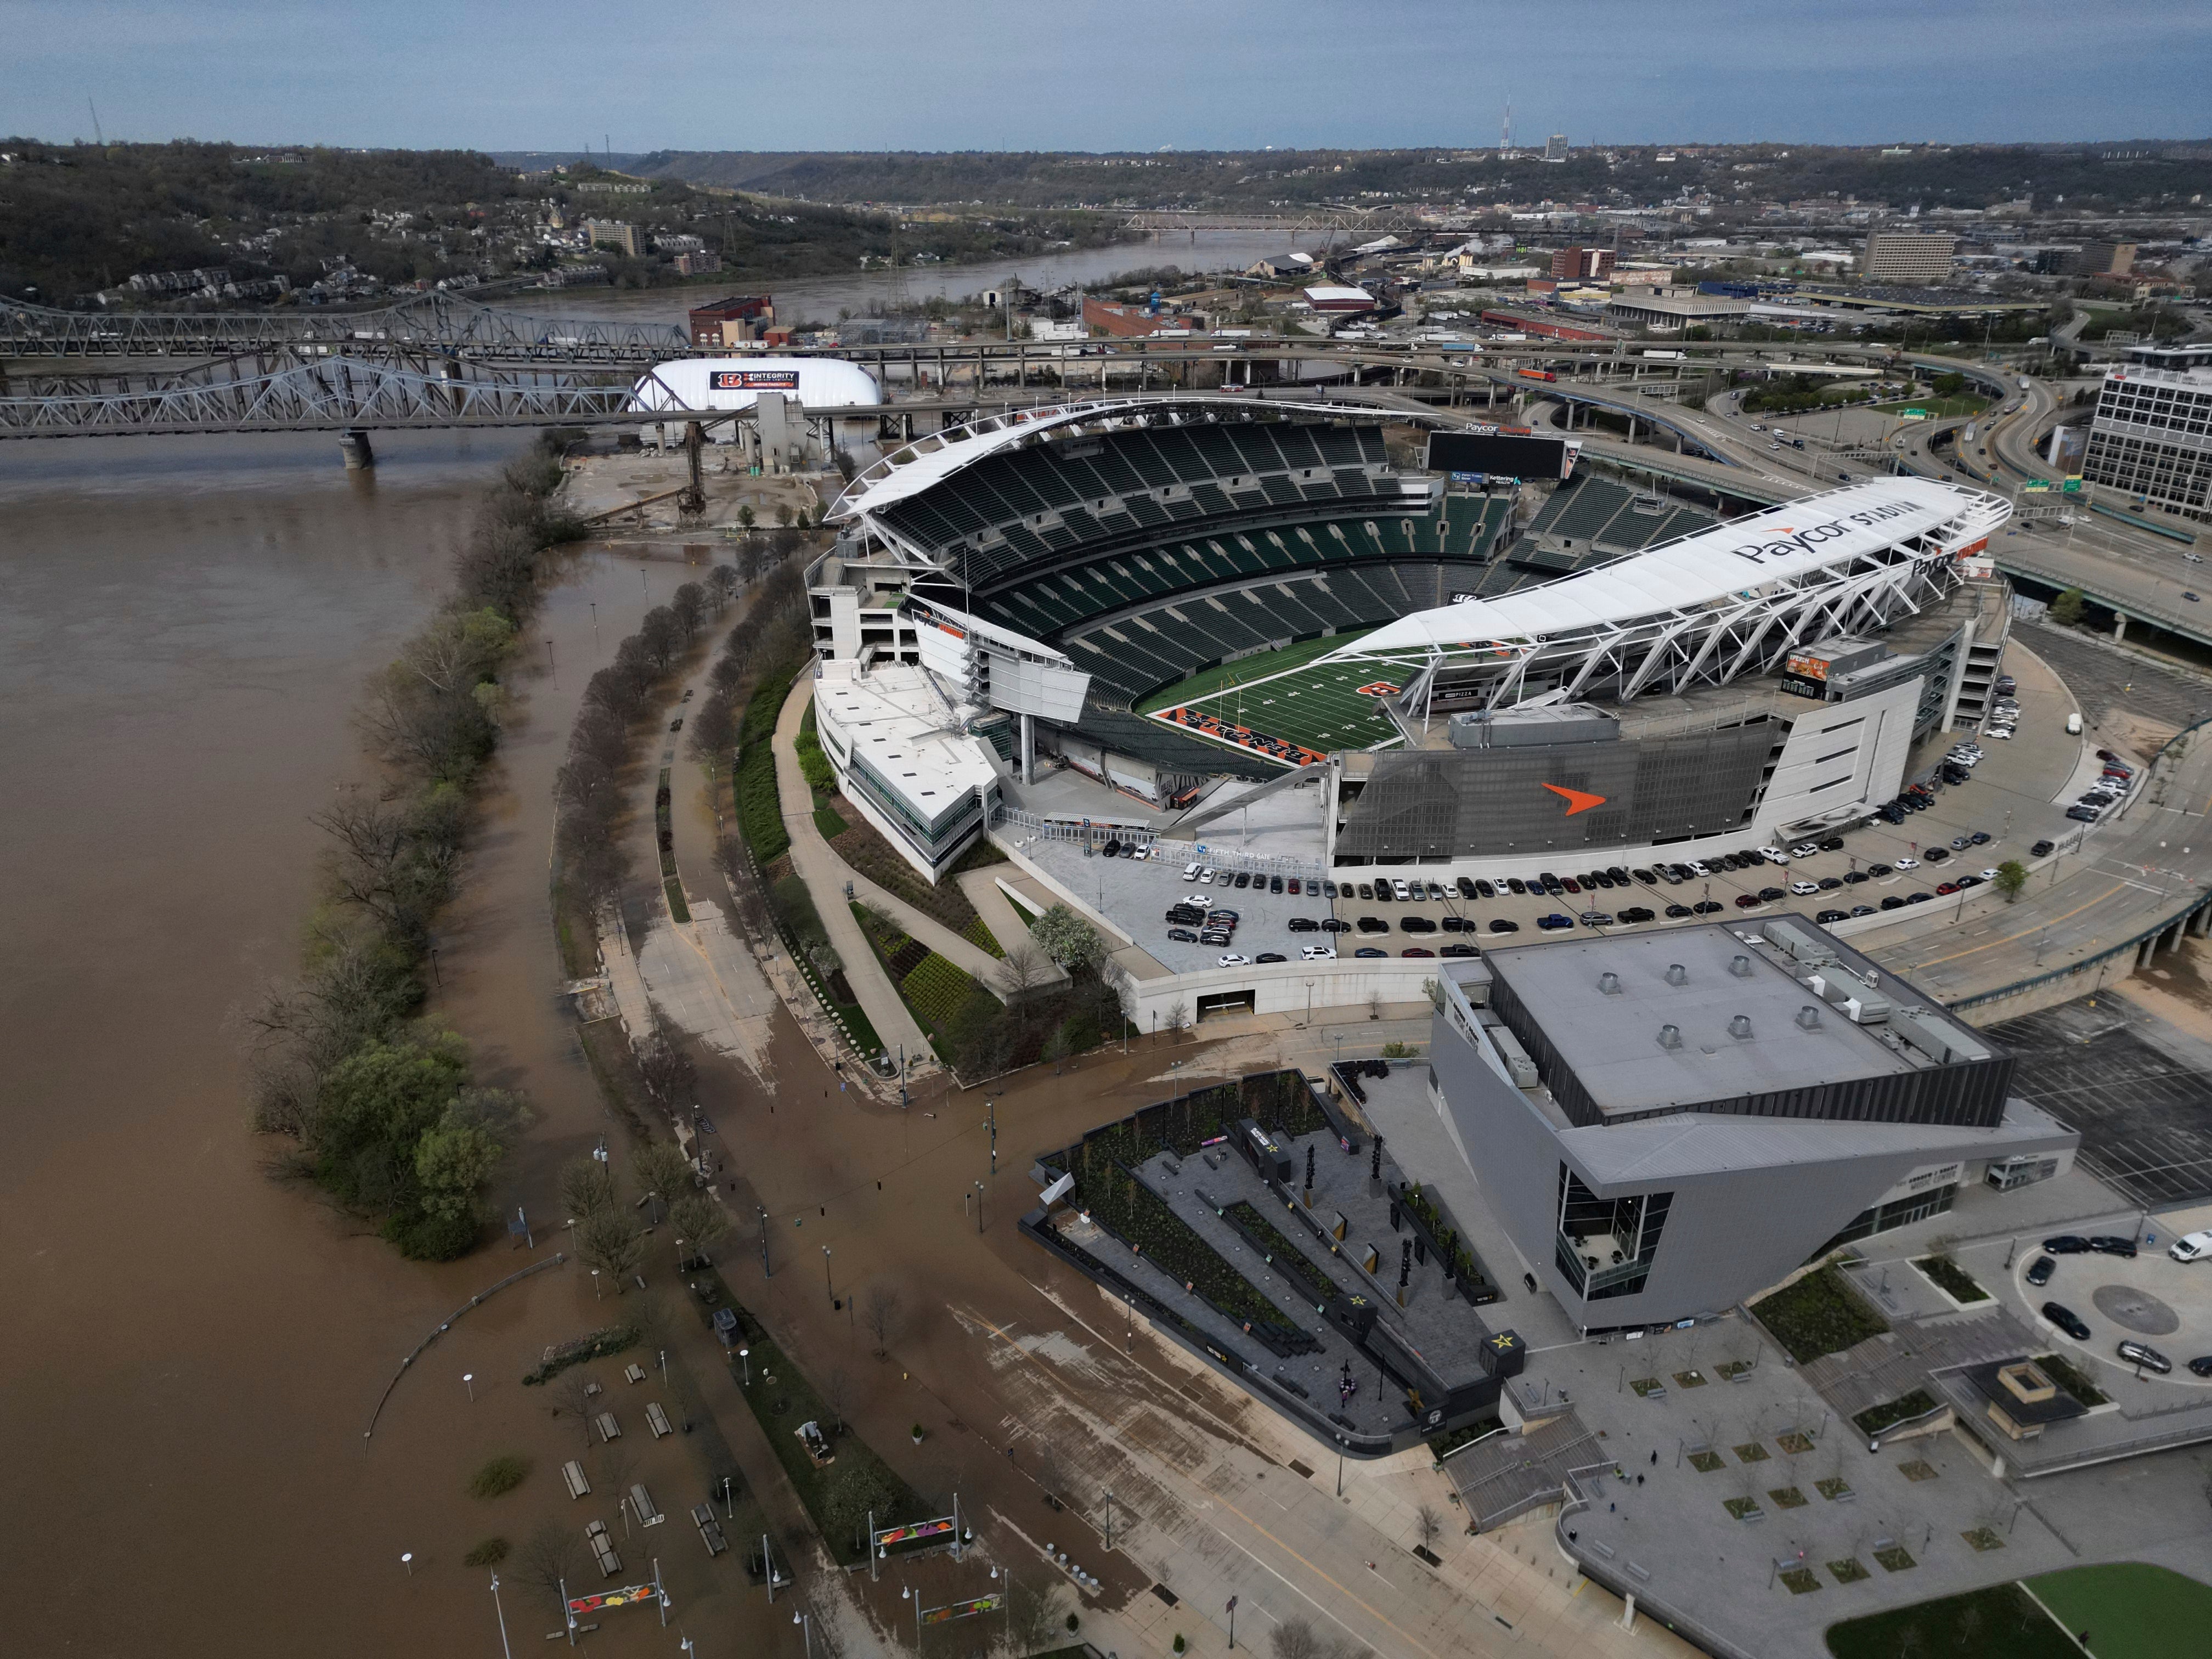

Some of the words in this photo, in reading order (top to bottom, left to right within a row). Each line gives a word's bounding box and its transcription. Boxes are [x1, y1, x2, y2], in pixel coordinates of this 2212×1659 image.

[1466, 422, 1498, 432] Paycor
[1730, 519, 1852, 565] Paycor
[1849, 501, 1925, 526] STADIUM
[1179, 715, 1310, 760] BENGALS
[1232, 850, 1255, 859] THIRD
[1465, 1030, 1479, 1053] CENTER
